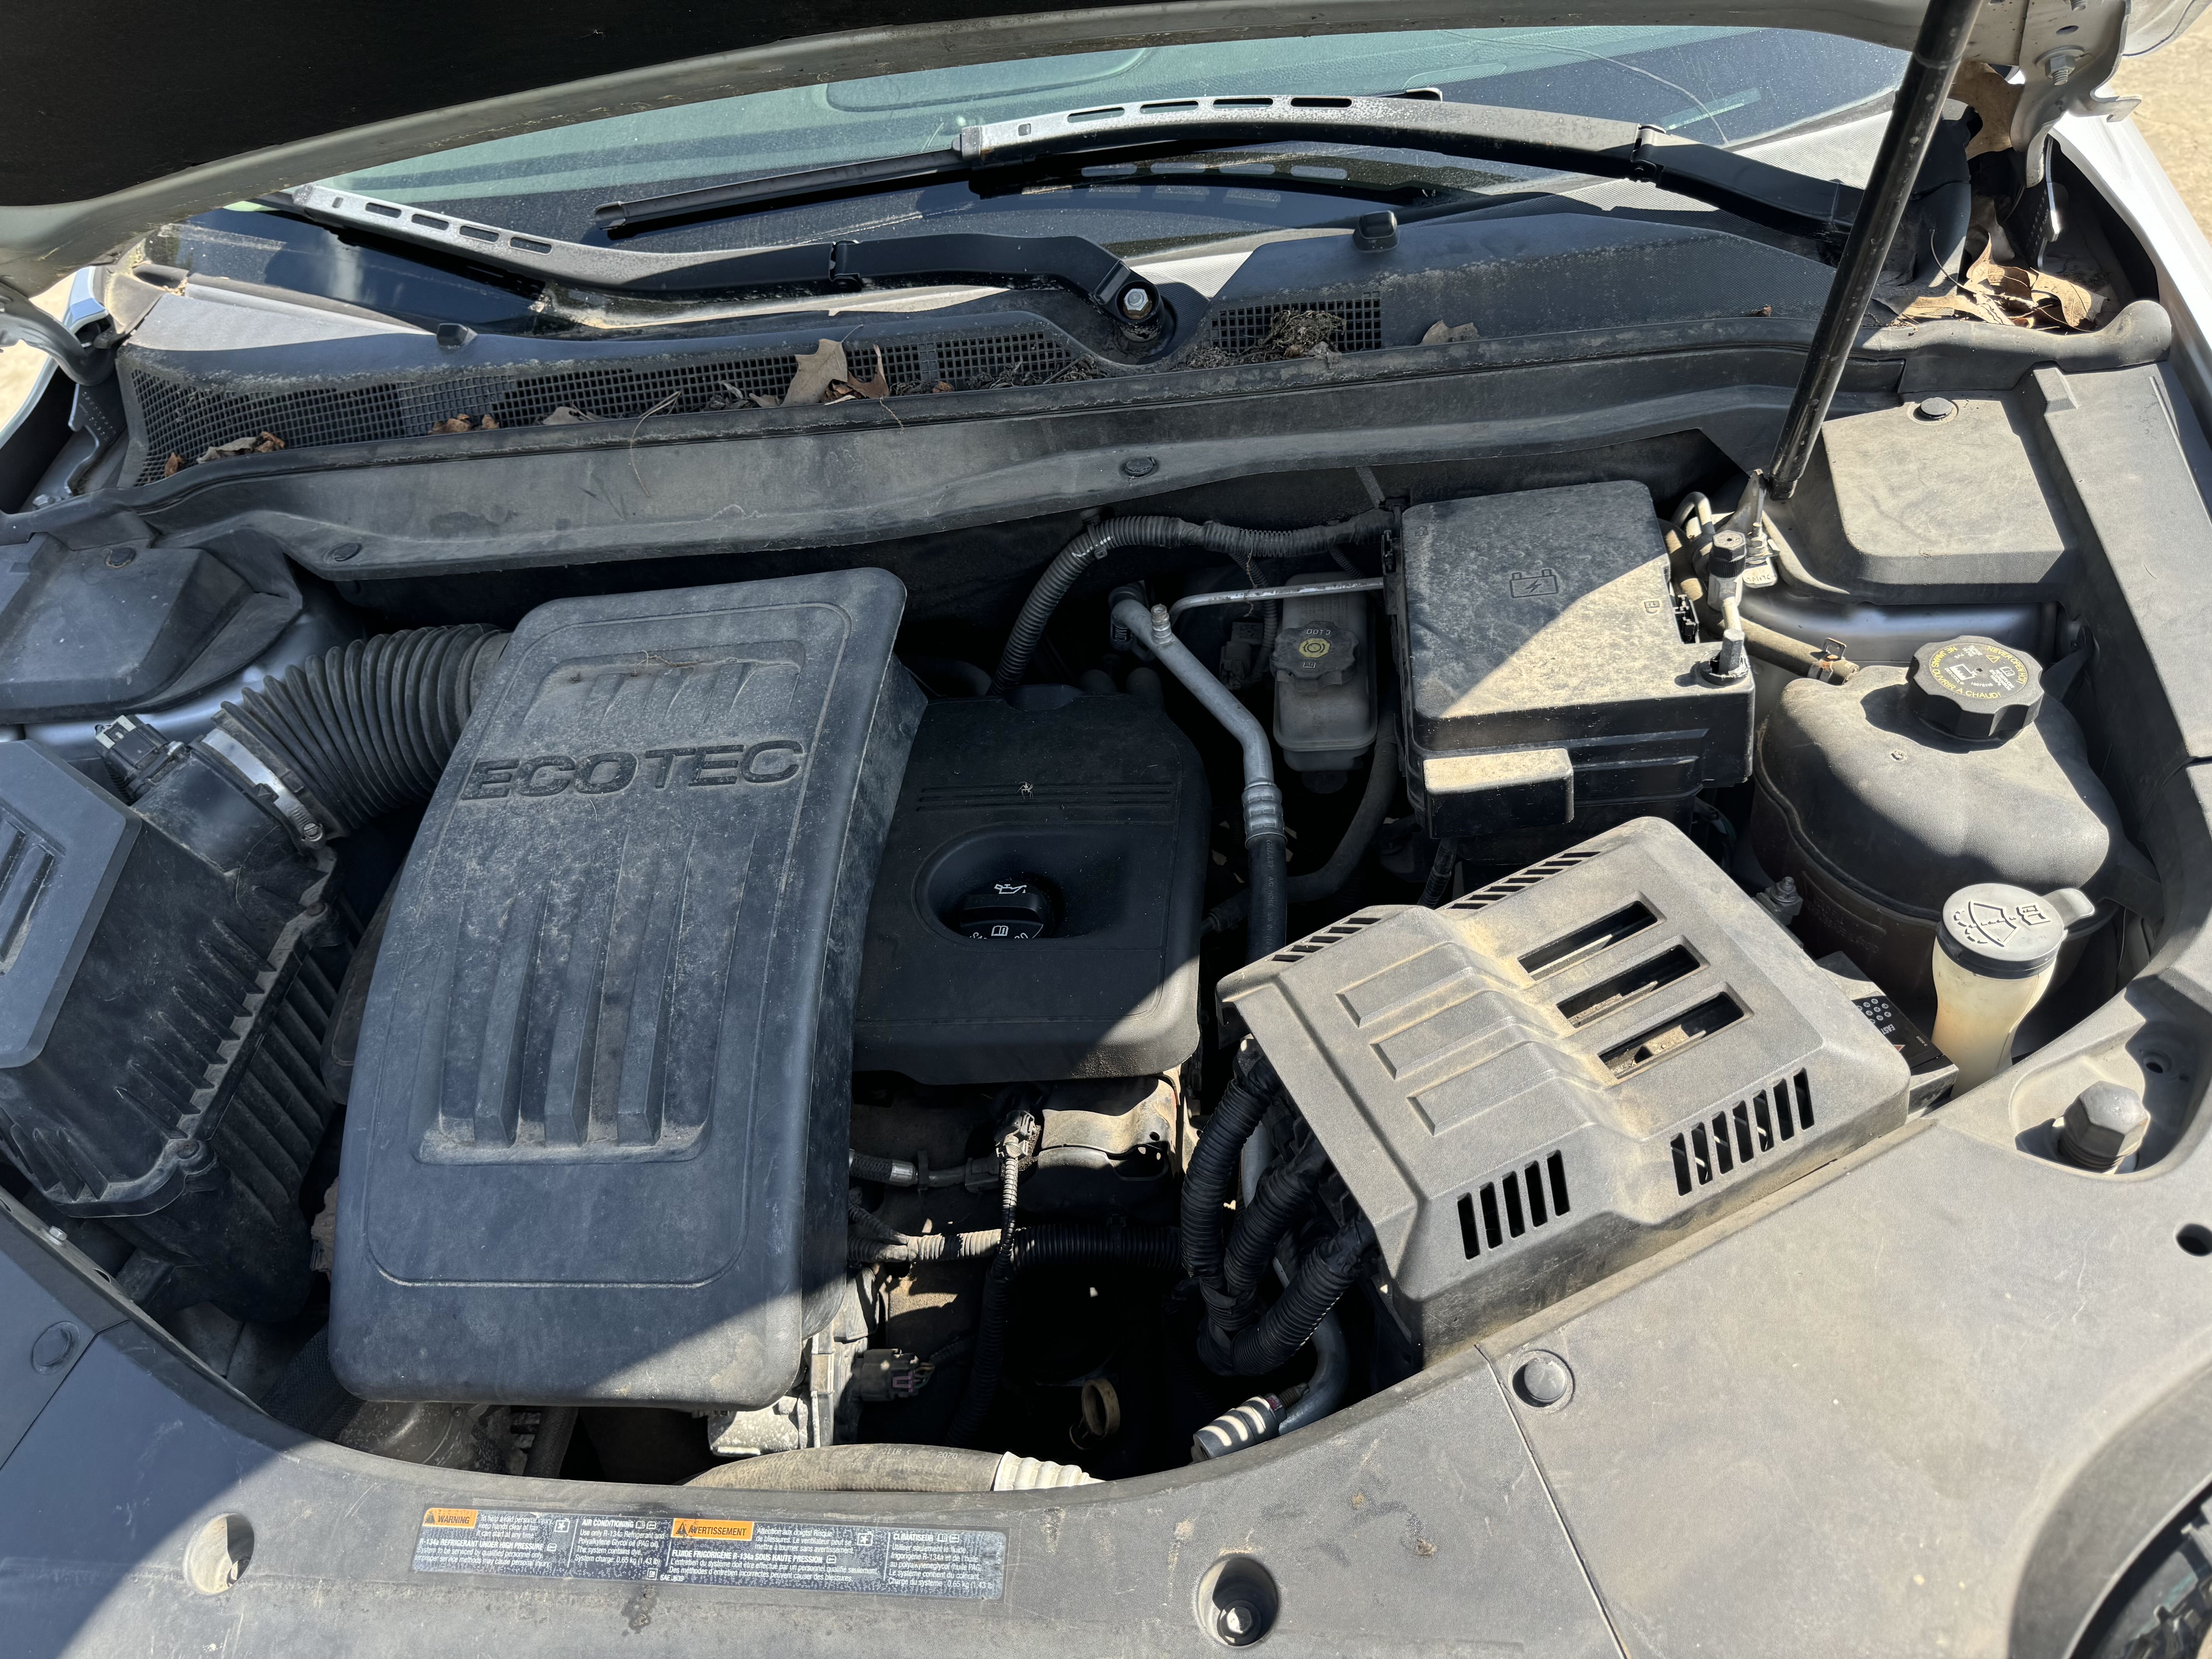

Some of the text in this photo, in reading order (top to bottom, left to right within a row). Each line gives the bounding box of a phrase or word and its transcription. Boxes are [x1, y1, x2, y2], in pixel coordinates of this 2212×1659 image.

[1944, 646, 1958, 654] NE
[1931, 651, 1947, 668] JAMAIS
[1987, 646, 2013, 660] NEVER
[2010, 658, 2025, 673] OPEN
[1932, 669, 1958, 690] OUVRIR
[461, 739, 805, 801] ECOTEC
[1881, 1024, 1896, 1035] EAST
[438, 1515, 470, 1524] WARNING
[487, 1515, 499, 1523] help
[514, 1516, 537, 1525] personal
[593, 1519, 635, 1528] CONDITIONING
[591, 1529, 603, 1537] only
[623, 1530, 654, 1539] Refrigerant
[688, 1525, 747, 1536] AVERTISSEMENT
[813, 1530, 833, 1538] Risque
[440, 1539, 479, 1547] REFRIGERANT
[578, 1537, 611, 1546] Polyalkylene
[611, 1538, 628, 1547] Glycol
[893, 1534, 934, 1542] CLIMATISEUR
[574, 1554, 594, 1562] System
[693, 1550, 732, 1559] FRIGORIGÈNE
[732, 1552, 754, 1560] R-134a
[754, 1553, 771, 1561] SOUS
[771, 1554, 793, 1562] HAUTE
[792, 1555, 823, 1563] PRESSION
[826, 1565, 847, 1573] qualifié
[951, 1563, 967, 1571] (huile
[709, 1568, 739, 1576] d'entretien
[739, 1570, 769, 1578] incorrectes
[888, 1577, 908, 1585] Charge
